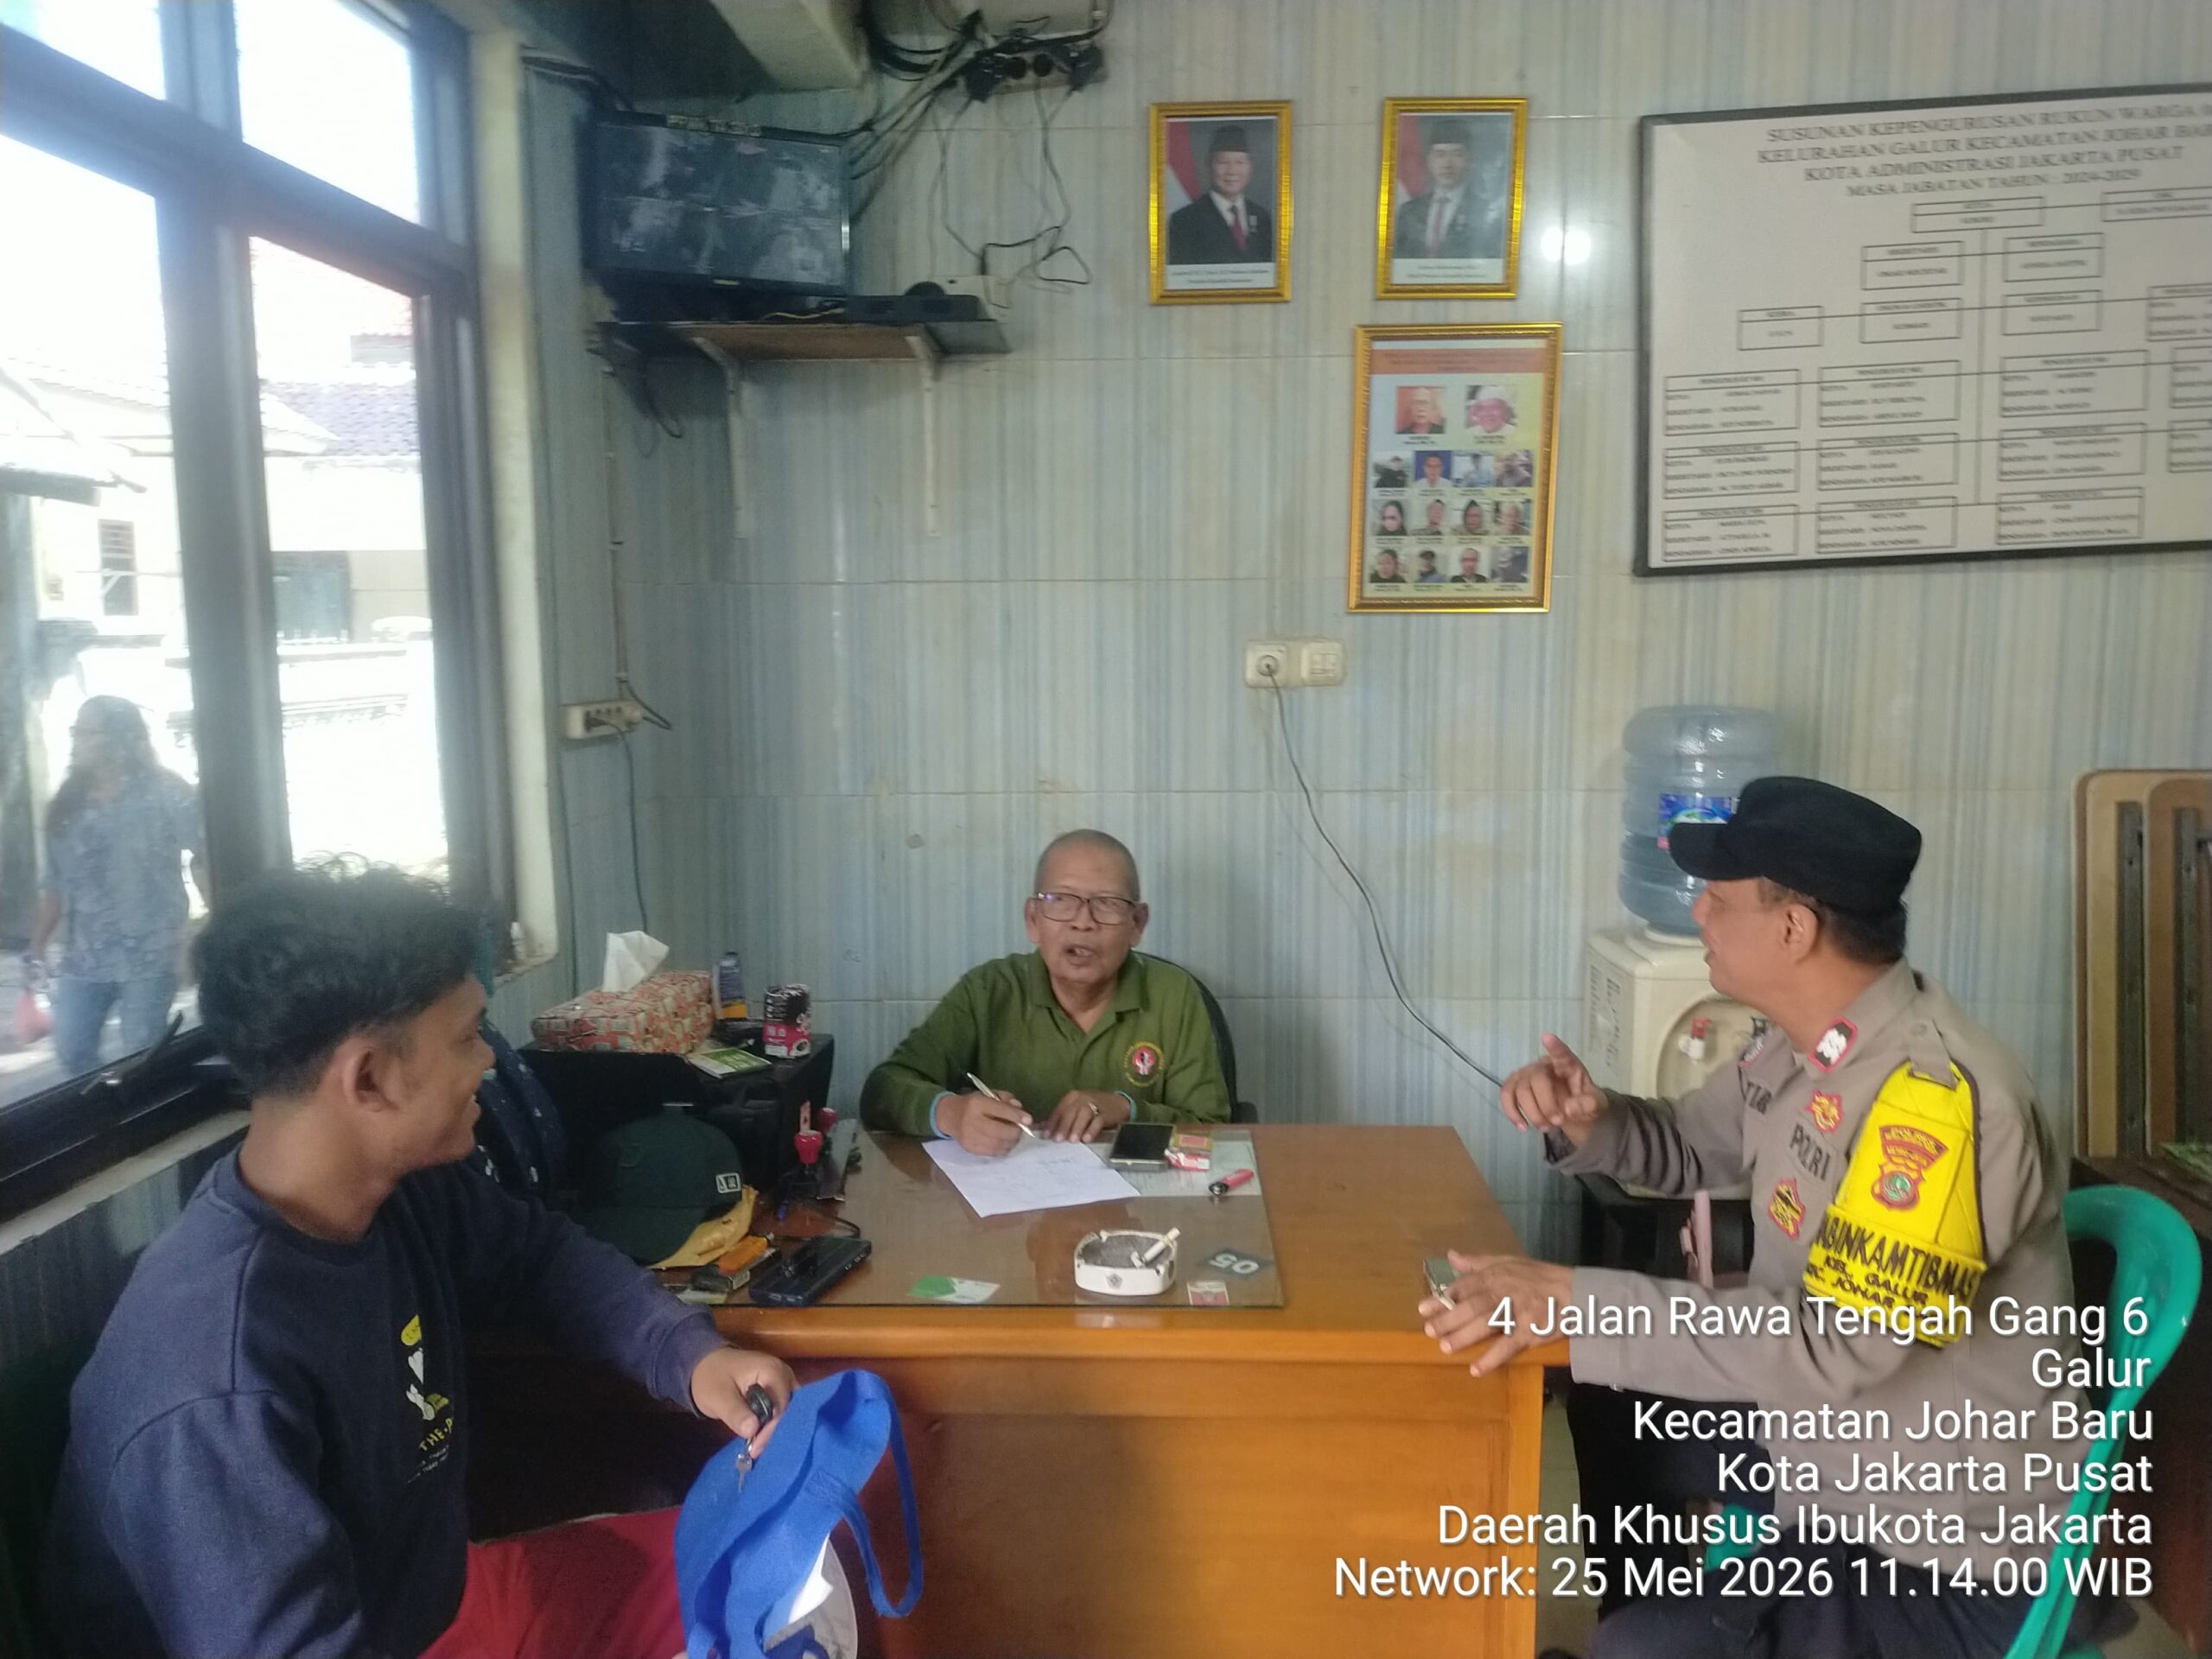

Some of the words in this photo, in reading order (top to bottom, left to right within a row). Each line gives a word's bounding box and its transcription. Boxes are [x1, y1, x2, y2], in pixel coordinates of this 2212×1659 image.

[1767, 124, 1863, 142] SUSUNAN
[1868, 114, 2034, 136] KEPENGURUSAN
[2039, 109, 2113, 125] RUKUN
[2119, 105, 2196, 119] WARGA
[1757, 143, 1885, 162] KELURAHAN
[1889, 138, 1960, 156] GALUR
[1965, 130, 2099, 150] KECAMATAN
[1804, 166, 1862, 181] KOTA
[1866, 156, 2015, 177] ADMINISTRASI
[2018, 150, 2113, 168] JAKARTA
[2117, 145, 2185, 162] PUSAT
[1847, 183, 1899, 197] MASA
